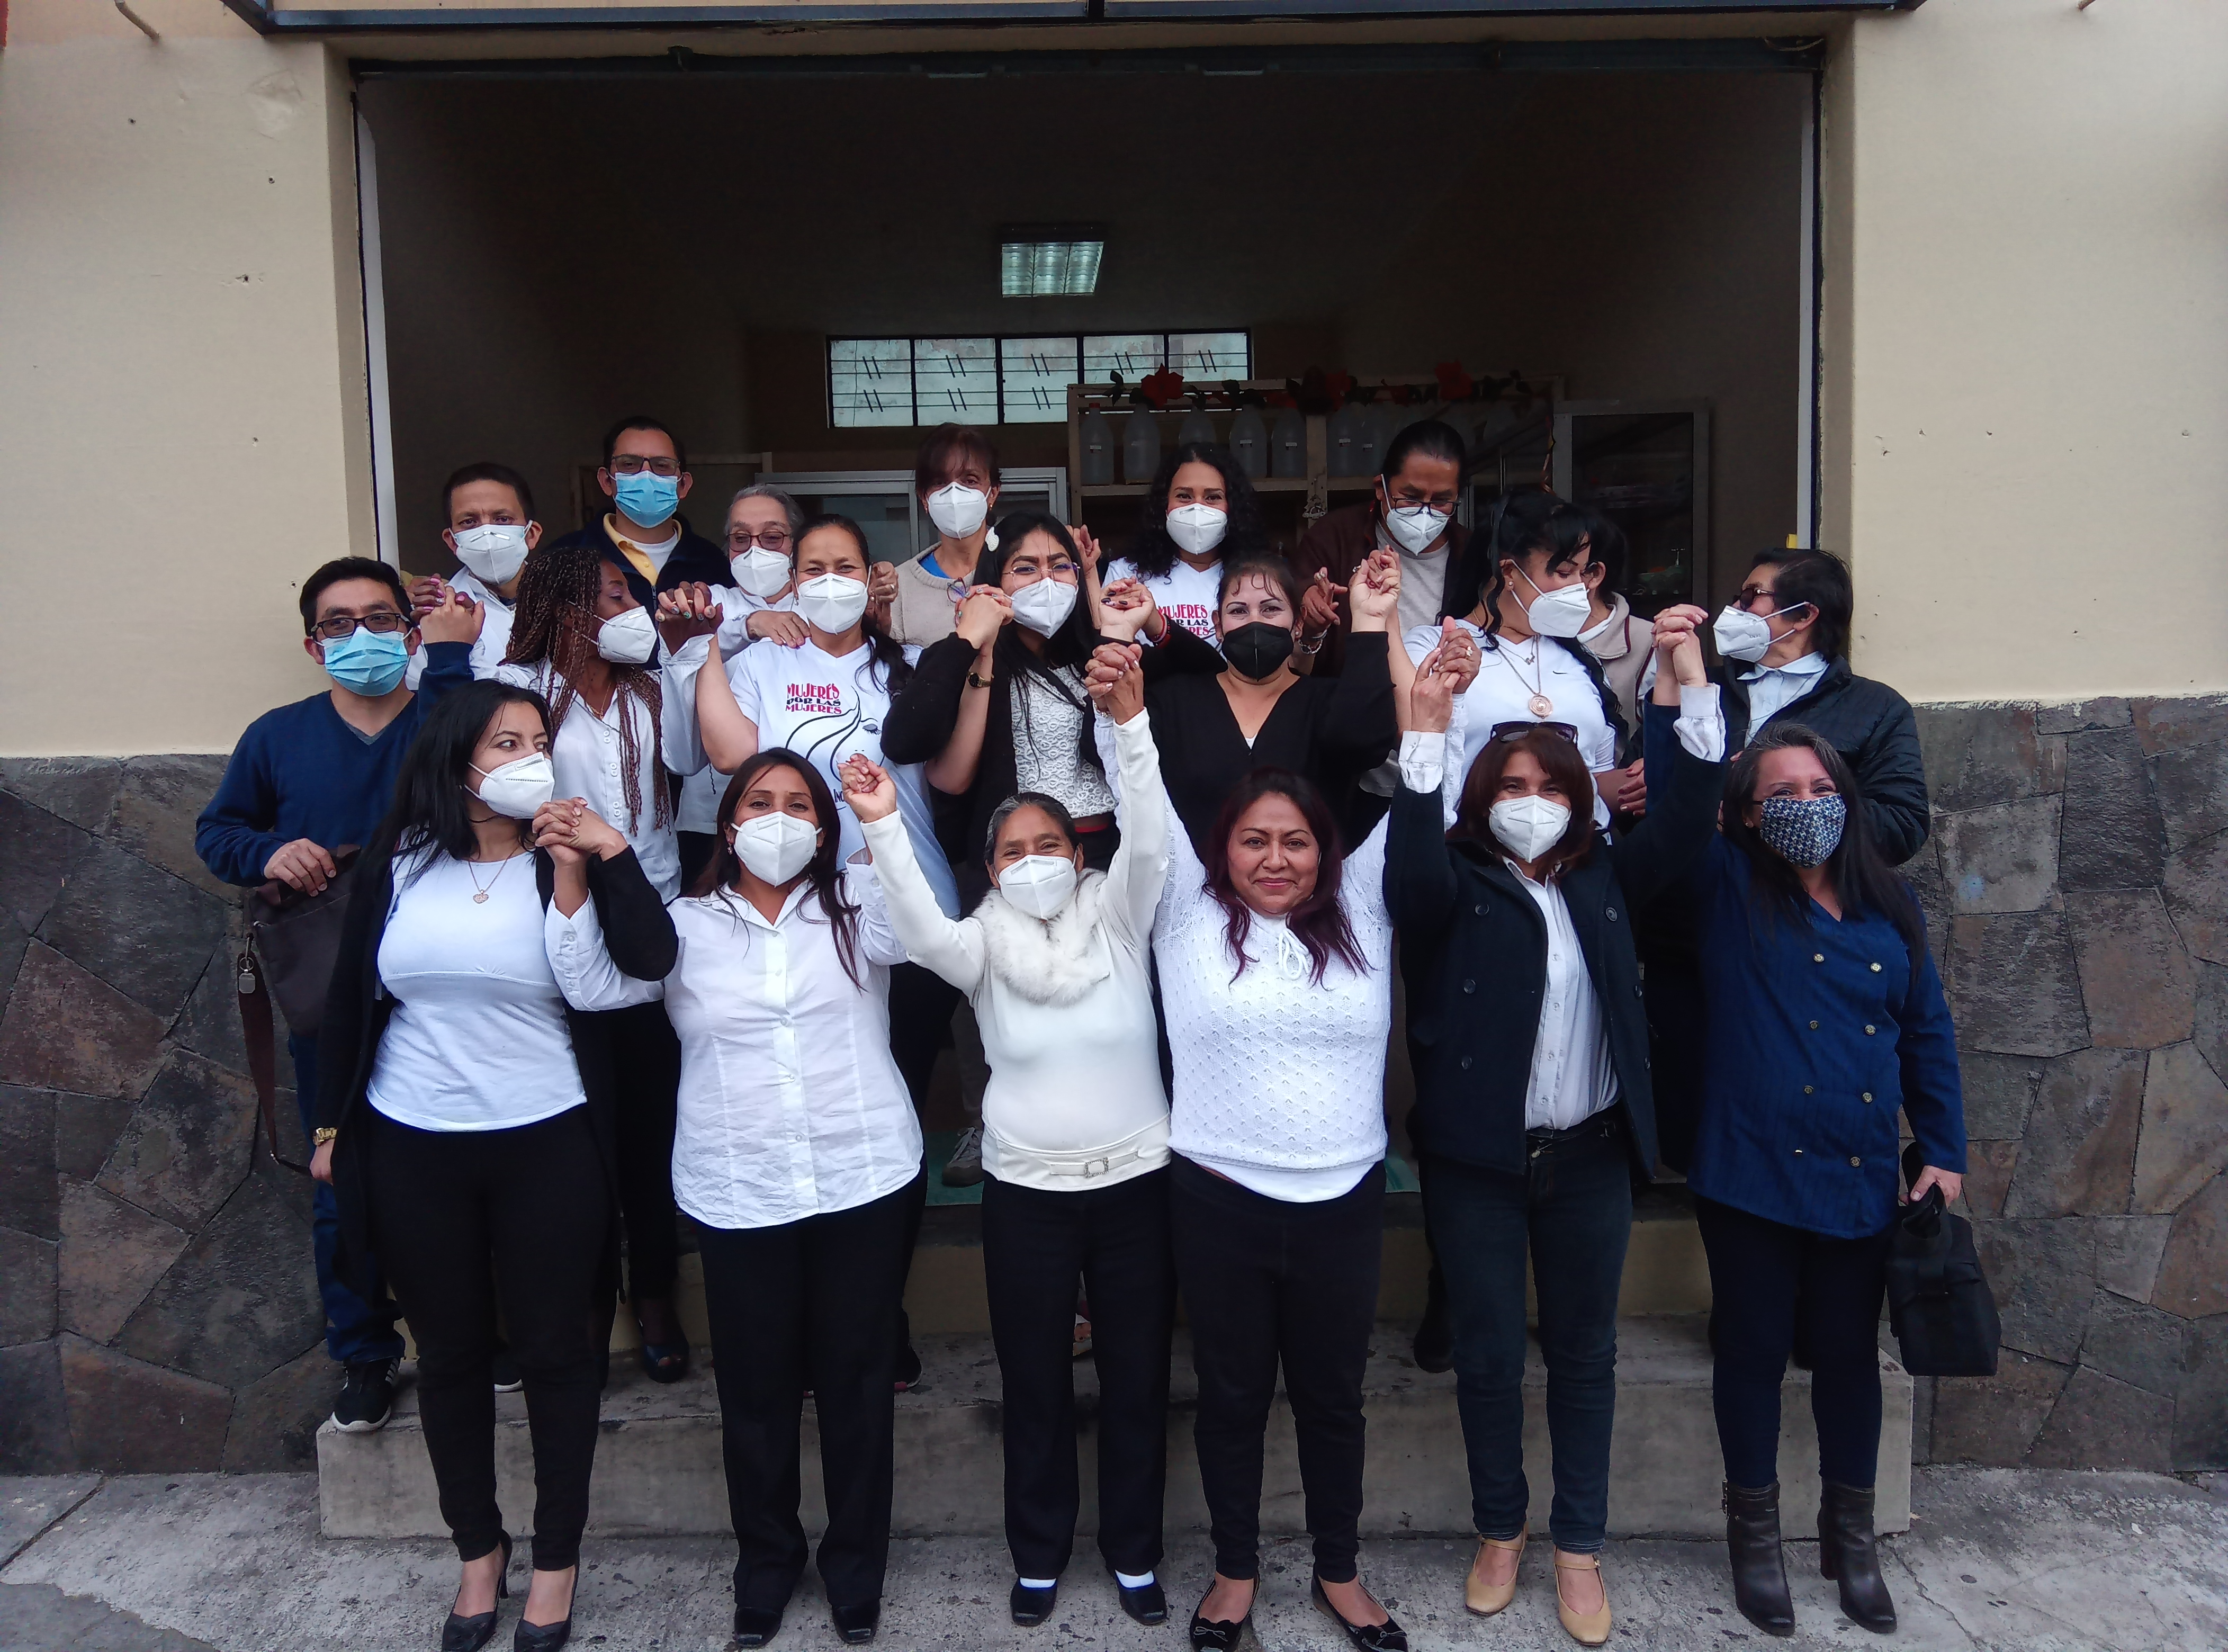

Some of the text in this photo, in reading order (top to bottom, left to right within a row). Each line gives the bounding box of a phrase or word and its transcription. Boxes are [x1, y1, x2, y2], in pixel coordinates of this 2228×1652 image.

[1158, 604, 1208, 619] MUJERES
[787, 683, 840, 699] MUJERES
[785, 703, 842, 714] MUJERES
